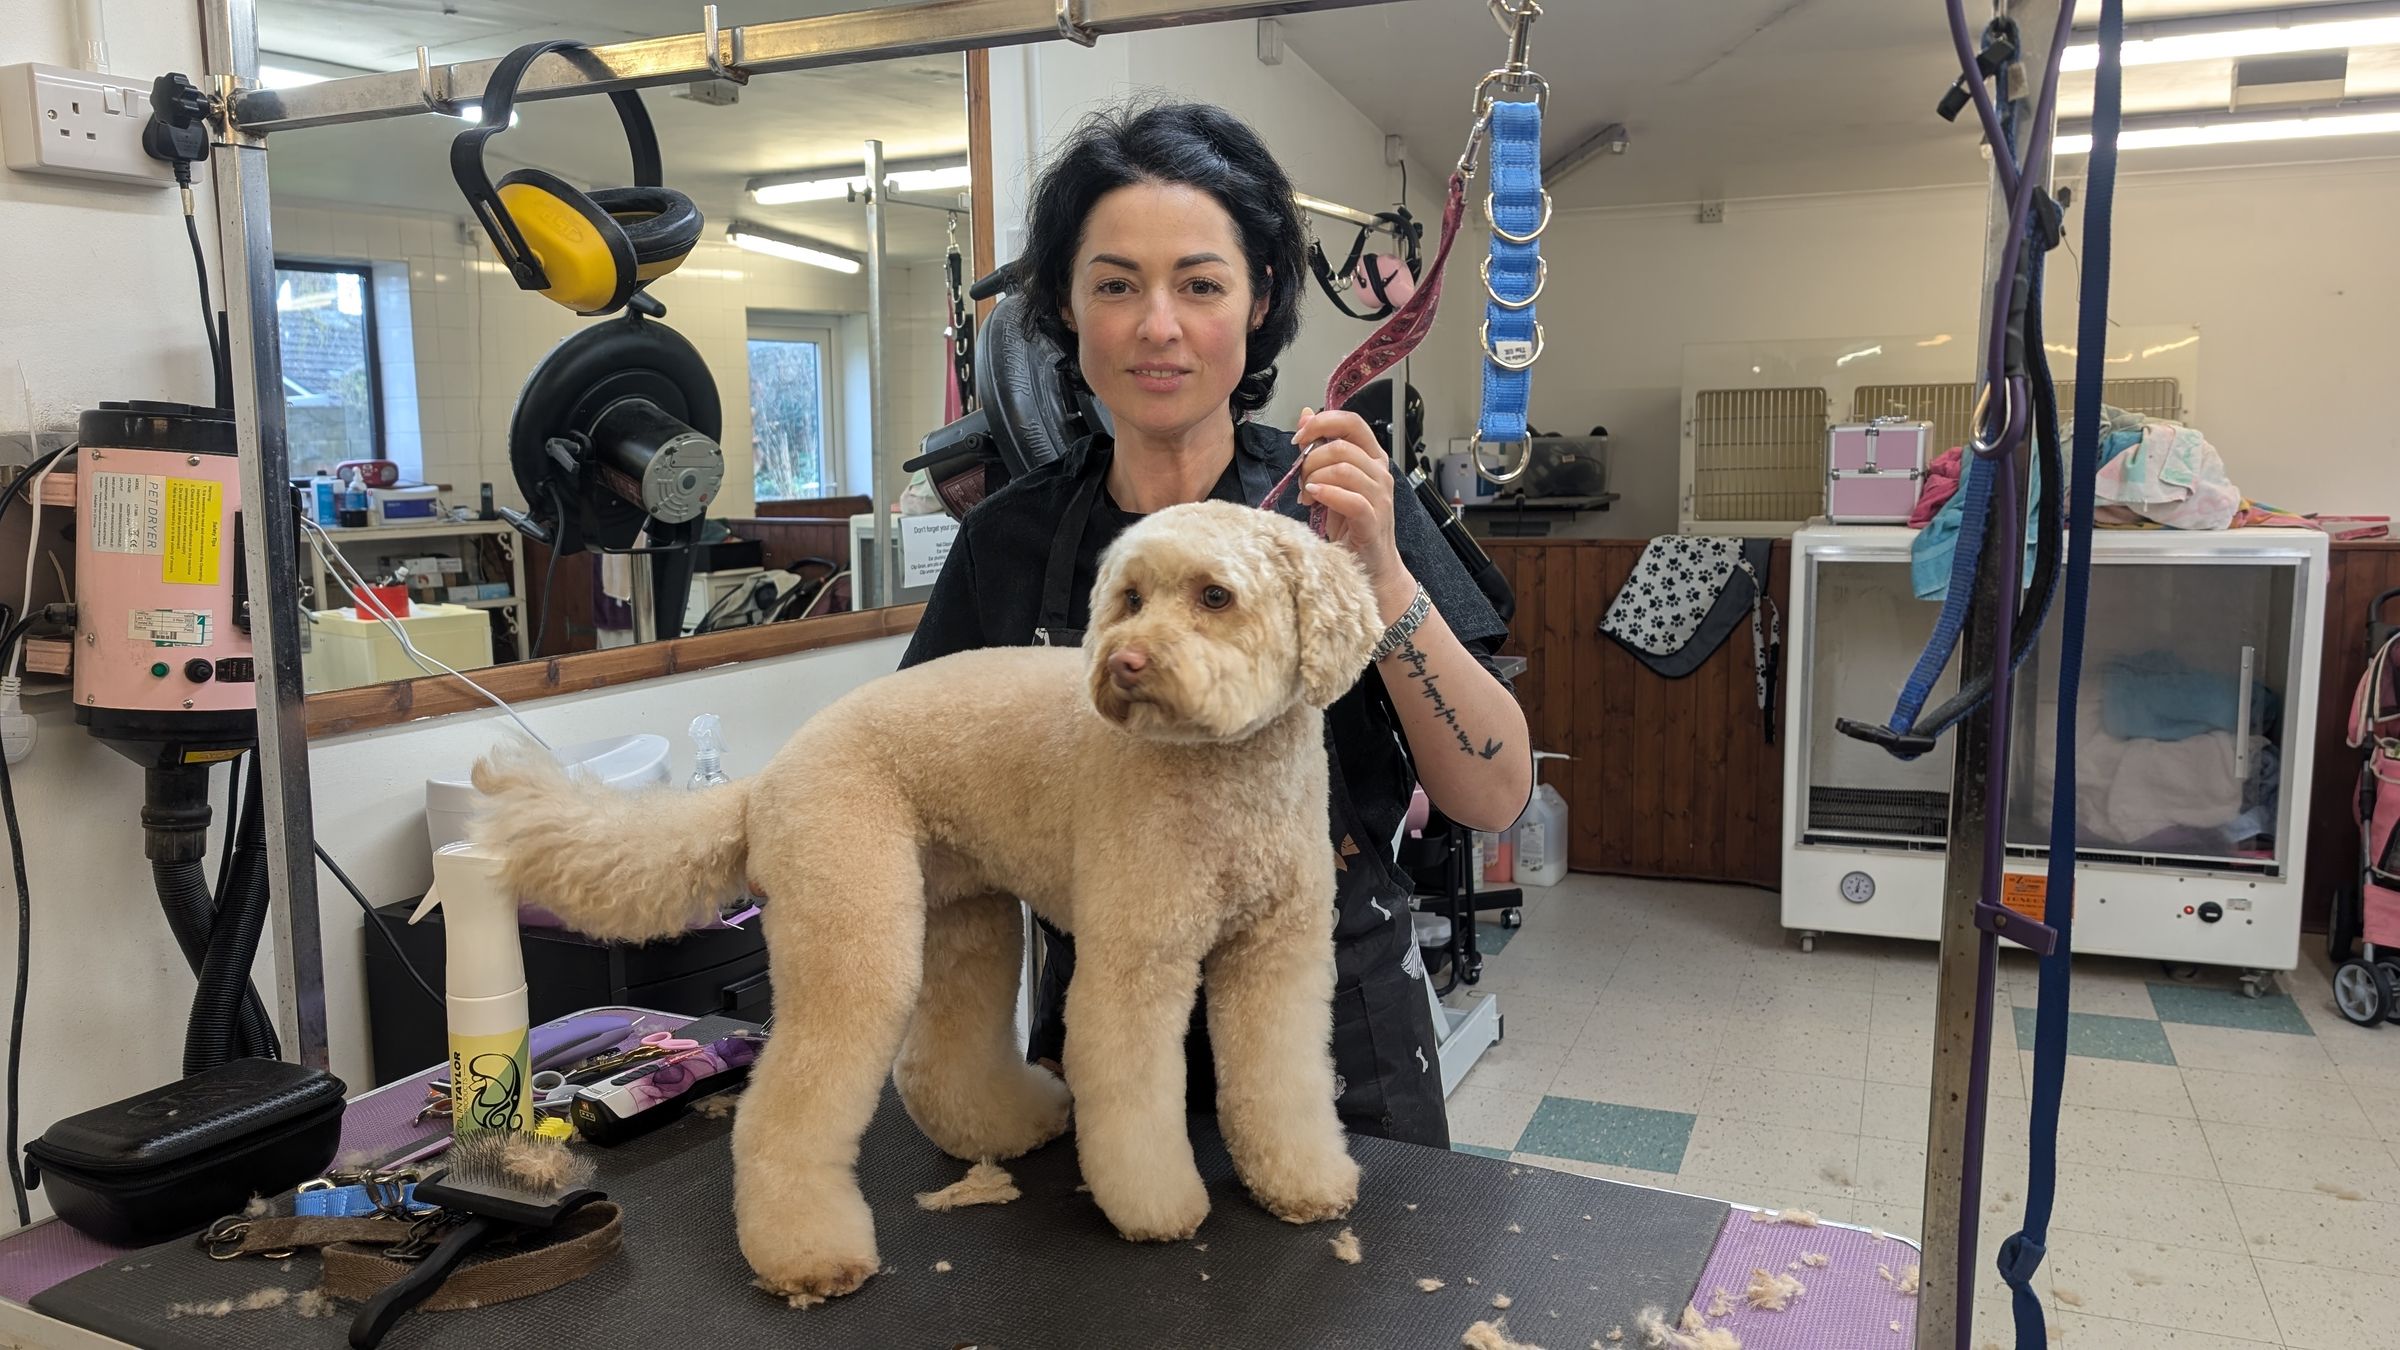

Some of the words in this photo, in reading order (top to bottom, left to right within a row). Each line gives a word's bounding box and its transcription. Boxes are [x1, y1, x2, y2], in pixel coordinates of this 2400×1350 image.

[1019, 419, 1051, 458] 9000
[149, 482, 158, 505] PET
[147, 507, 157, 548] DRYER
[914, 526, 926, 534] Don't
[1433, 708, 1456, 725] for
